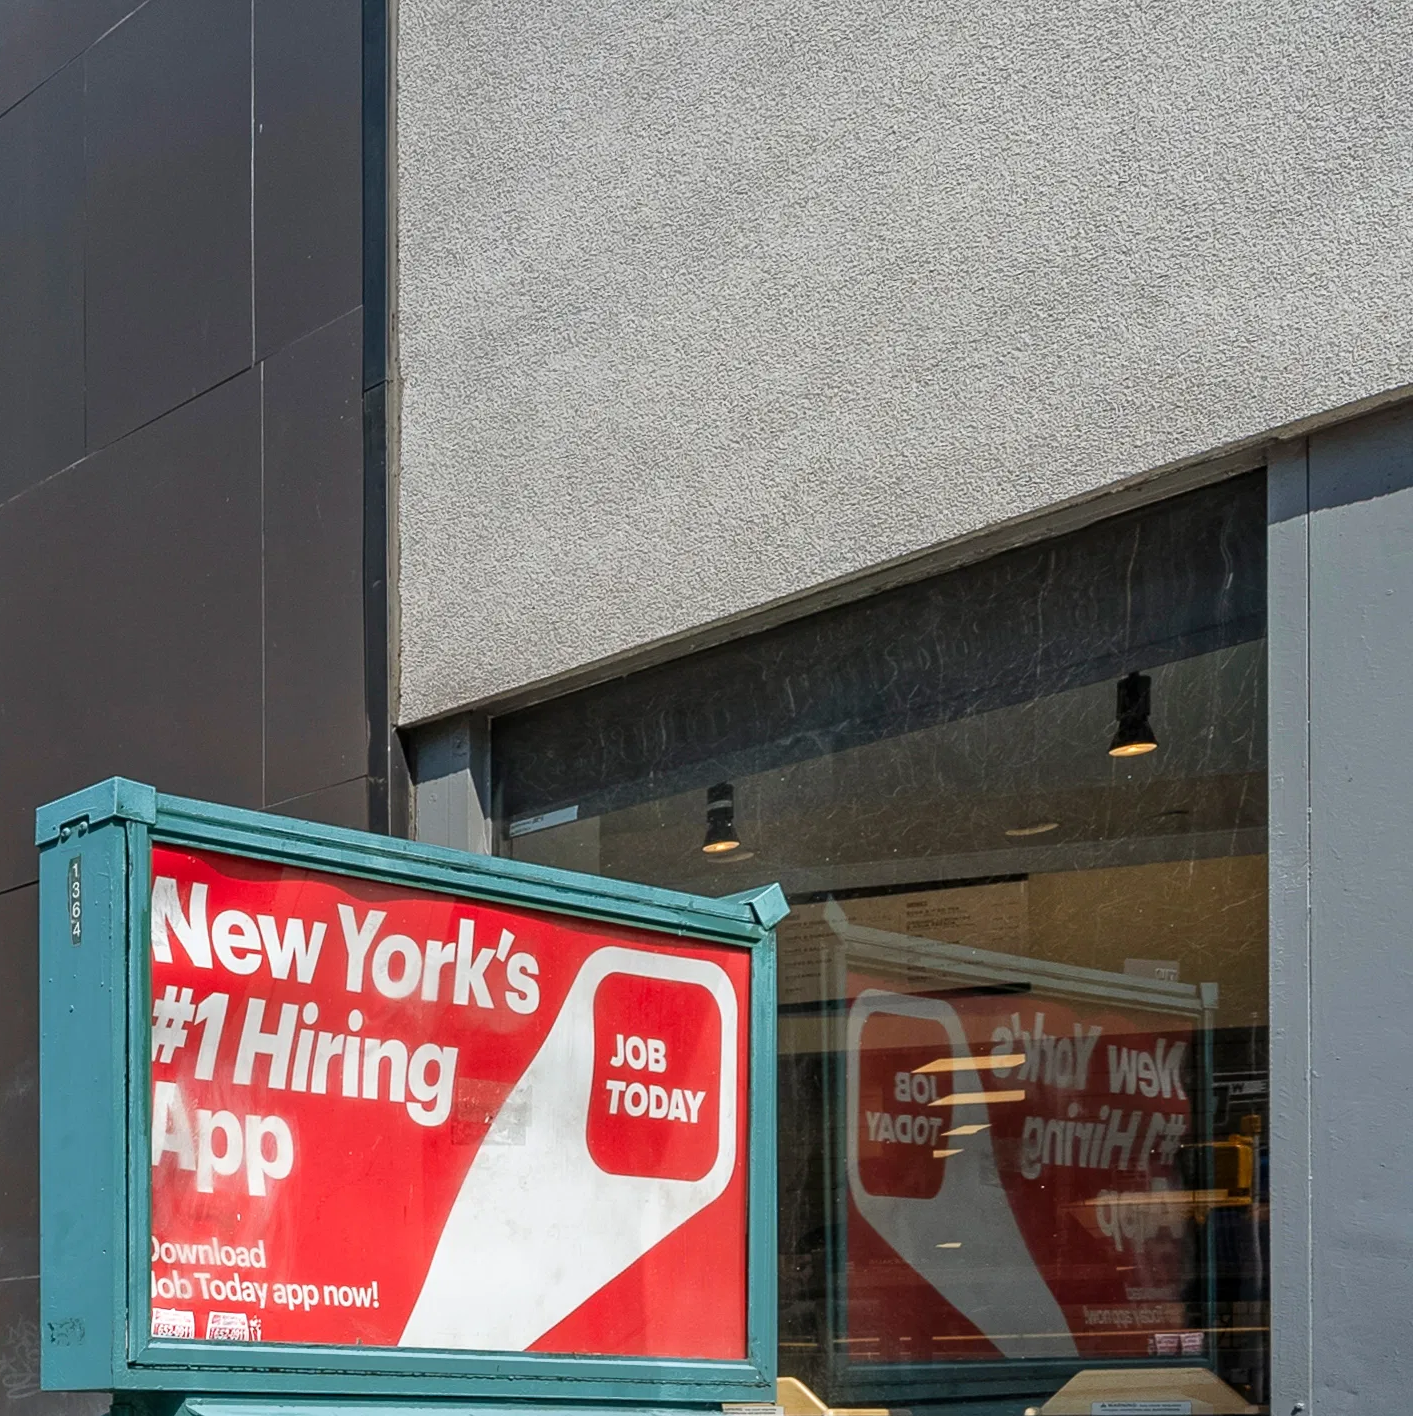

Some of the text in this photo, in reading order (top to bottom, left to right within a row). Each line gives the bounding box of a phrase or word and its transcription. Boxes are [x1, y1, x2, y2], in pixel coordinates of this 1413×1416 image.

[72, 863, 81, 937] 1364
[151, 876, 540, 1016] New York's
[151, 985, 458, 1127] #1 Hiring
[610, 1034, 667, 1073] JOB
[152, 1081, 294, 1196] App
[606, 1080, 706, 1124] TODAY
[193, 1272, 268, 1309] Today
[273, 1282, 319, 1311] app
[323, 1281, 380, 1308] now!
